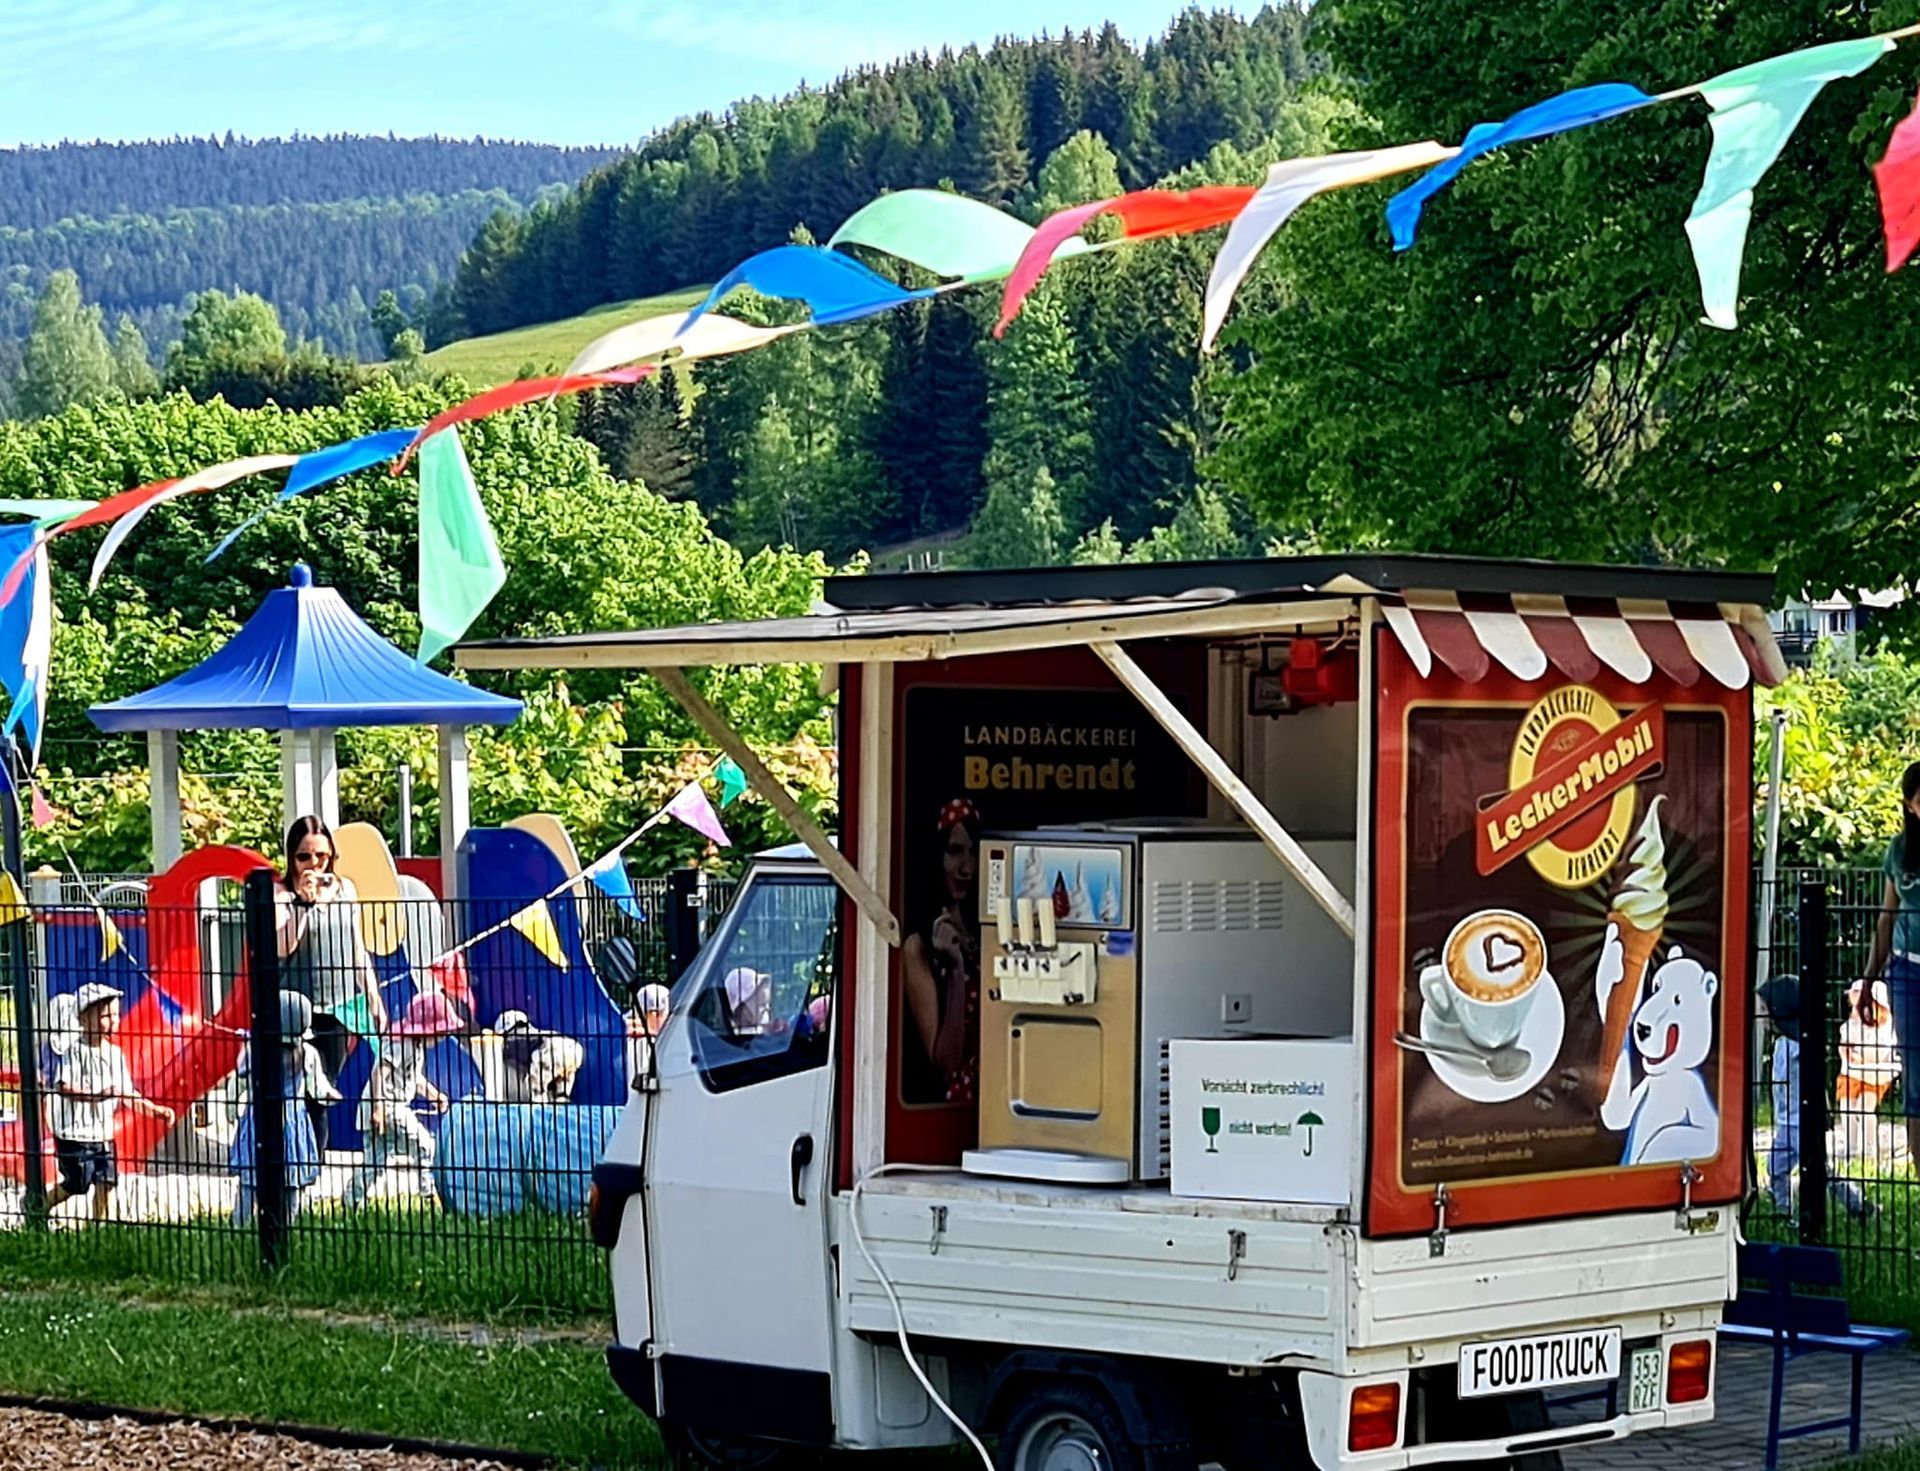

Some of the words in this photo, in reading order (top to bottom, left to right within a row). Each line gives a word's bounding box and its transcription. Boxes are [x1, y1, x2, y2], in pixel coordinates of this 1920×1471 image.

[964, 723, 1136, 746] LANDBÄCKEREI
[964, 755, 1136, 790] Behrendt
[1487, 720, 1654, 852] LeckerMobil
[1201, 1078, 1247, 1093] Vorsicht
[1473, 1335, 1609, 1389] FOODTRUCK
[1634, 1354, 1660, 1380] 353
[1633, 1382, 1658, 1409] RZF
